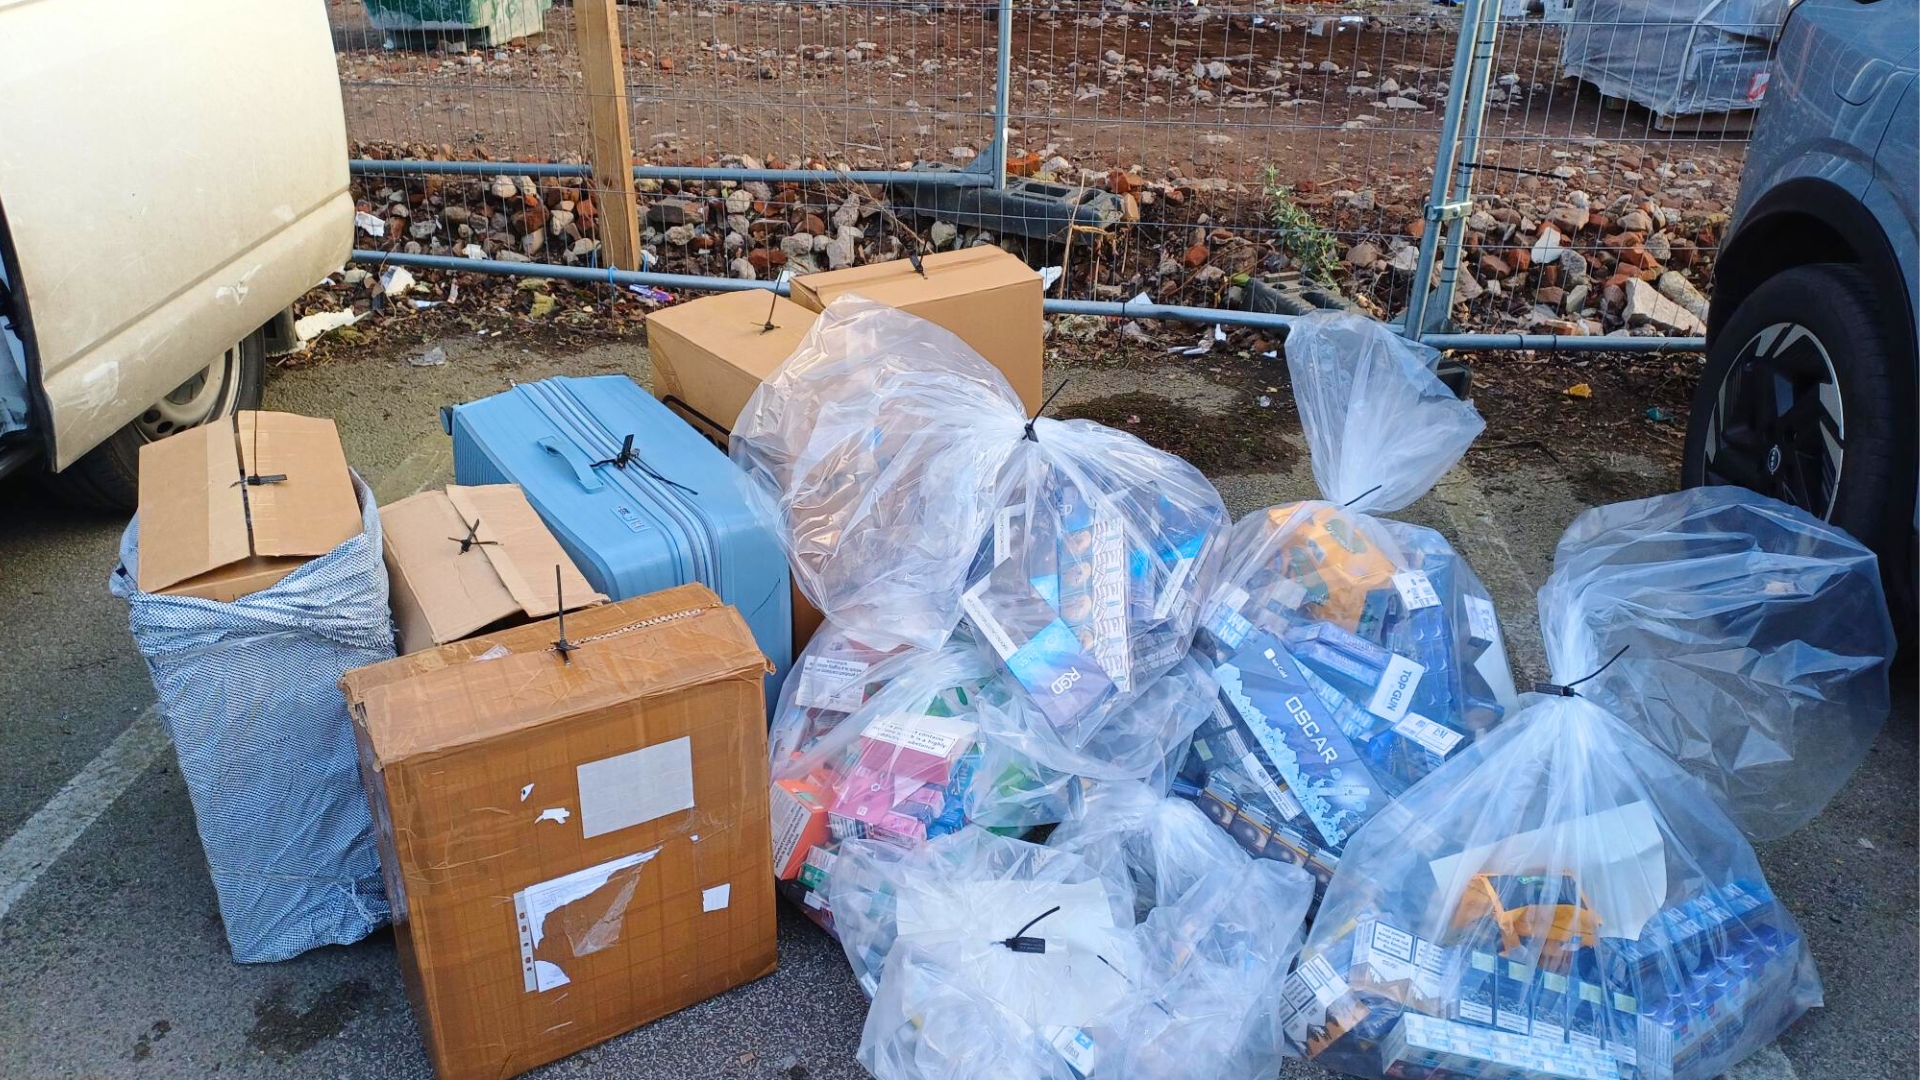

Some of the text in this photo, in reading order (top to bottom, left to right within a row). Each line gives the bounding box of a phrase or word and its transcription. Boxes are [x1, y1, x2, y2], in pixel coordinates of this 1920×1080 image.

[1051, 666, 1081, 694] RGD
[1386, 670, 1412, 712] TOP GUN
[1285, 696, 1338, 765] OSCAR
